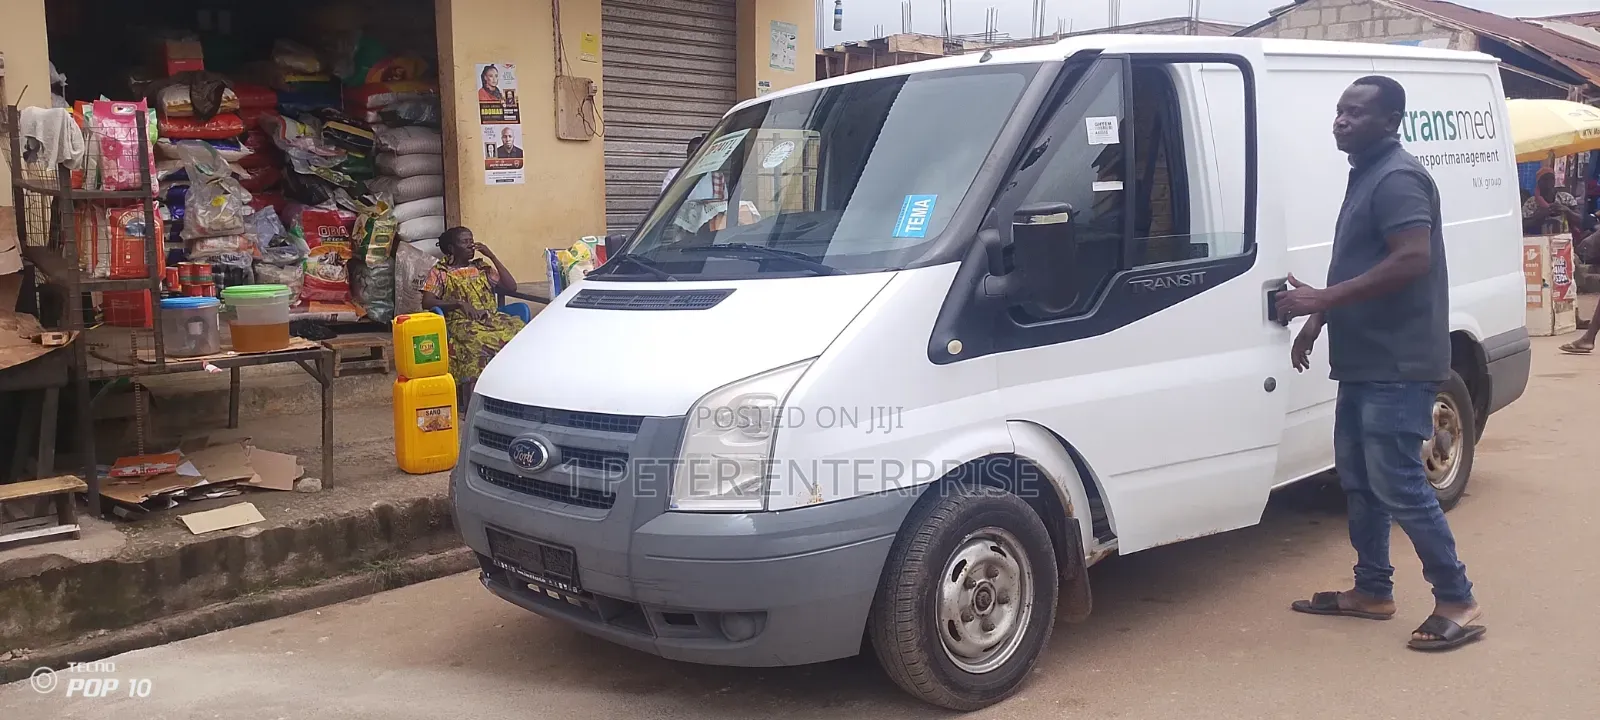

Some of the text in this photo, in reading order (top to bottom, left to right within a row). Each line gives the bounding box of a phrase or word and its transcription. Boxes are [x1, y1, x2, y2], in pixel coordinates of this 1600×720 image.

[904, 198, 932, 233] TEMA
[1128, 271, 1206, 293] TRANSIT
[513, 443, 535, 465] Ford
